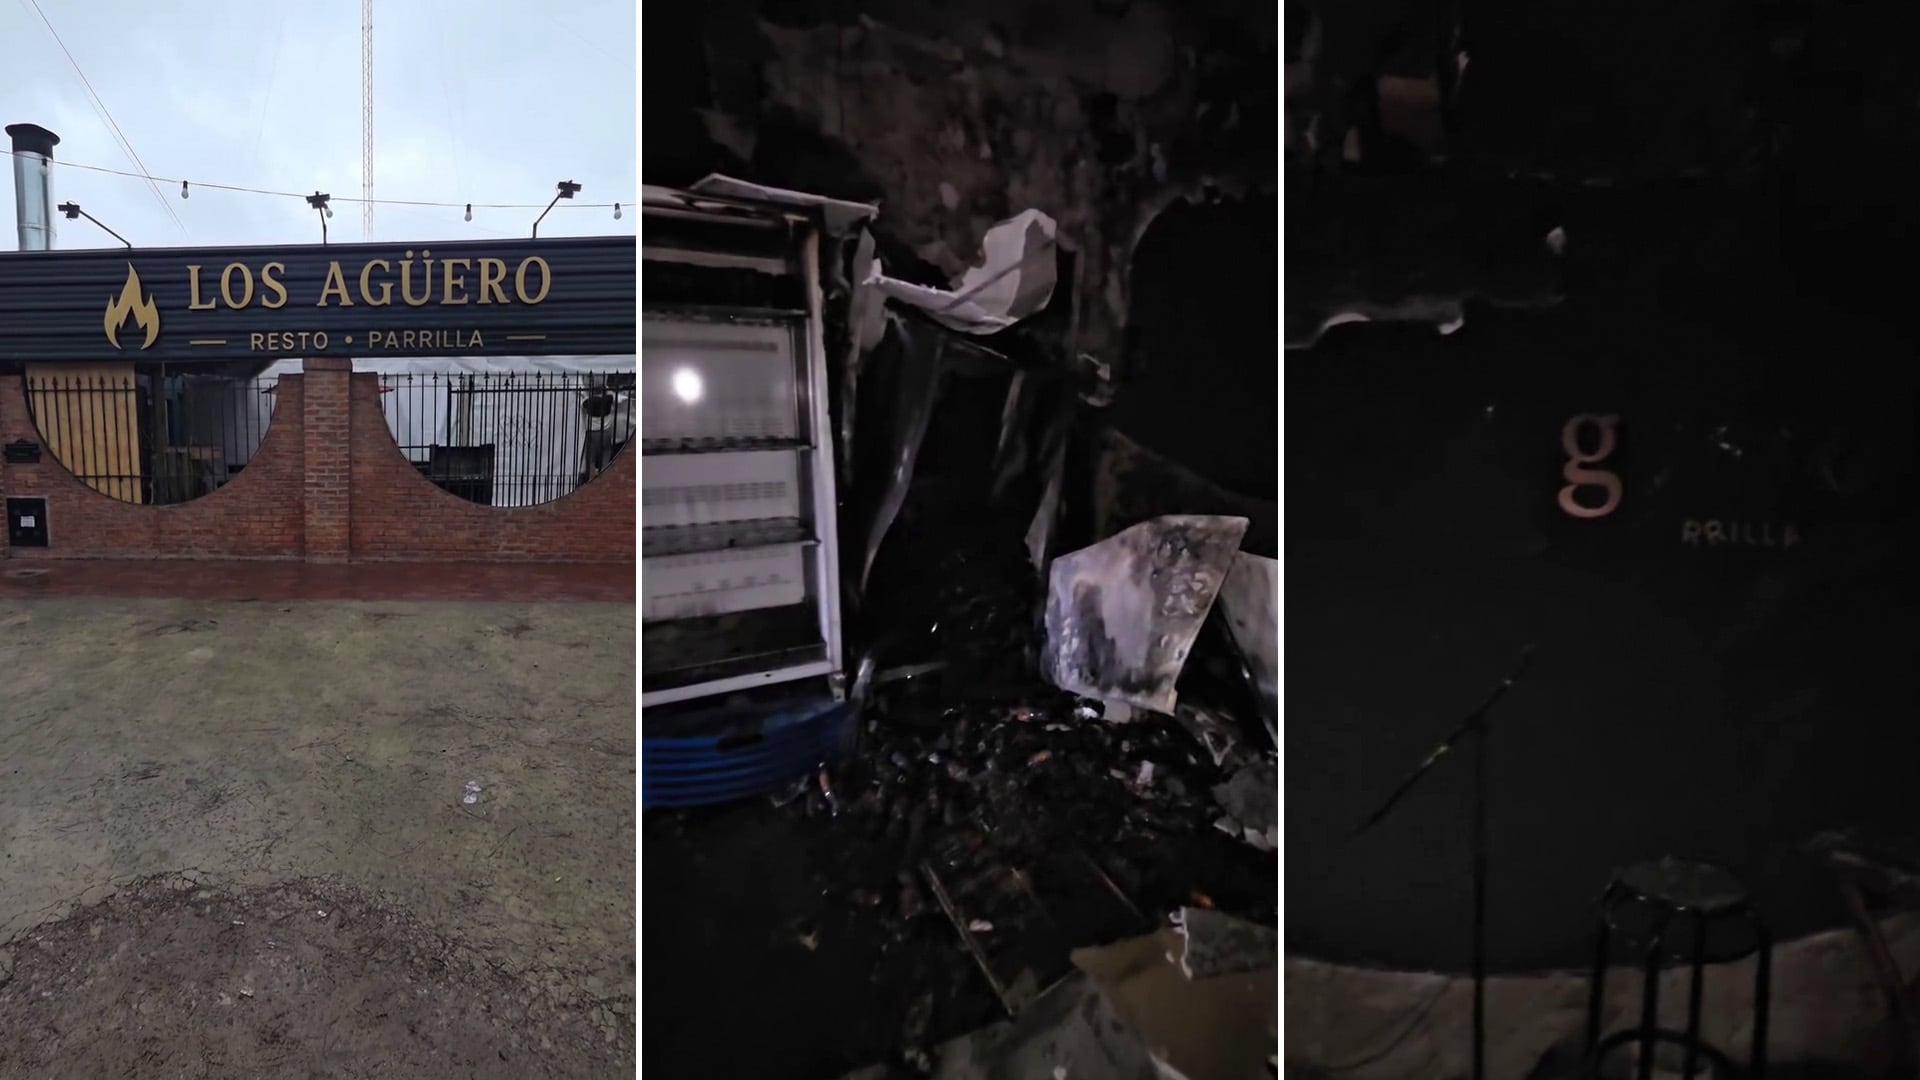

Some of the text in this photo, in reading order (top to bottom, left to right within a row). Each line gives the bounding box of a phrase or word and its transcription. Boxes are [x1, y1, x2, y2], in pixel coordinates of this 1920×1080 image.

[187, 249, 552, 310] LOS AGÜERO
[251, 330, 484, 351] RESTO PARRILLA
[1557, 412, 1623, 518] g
